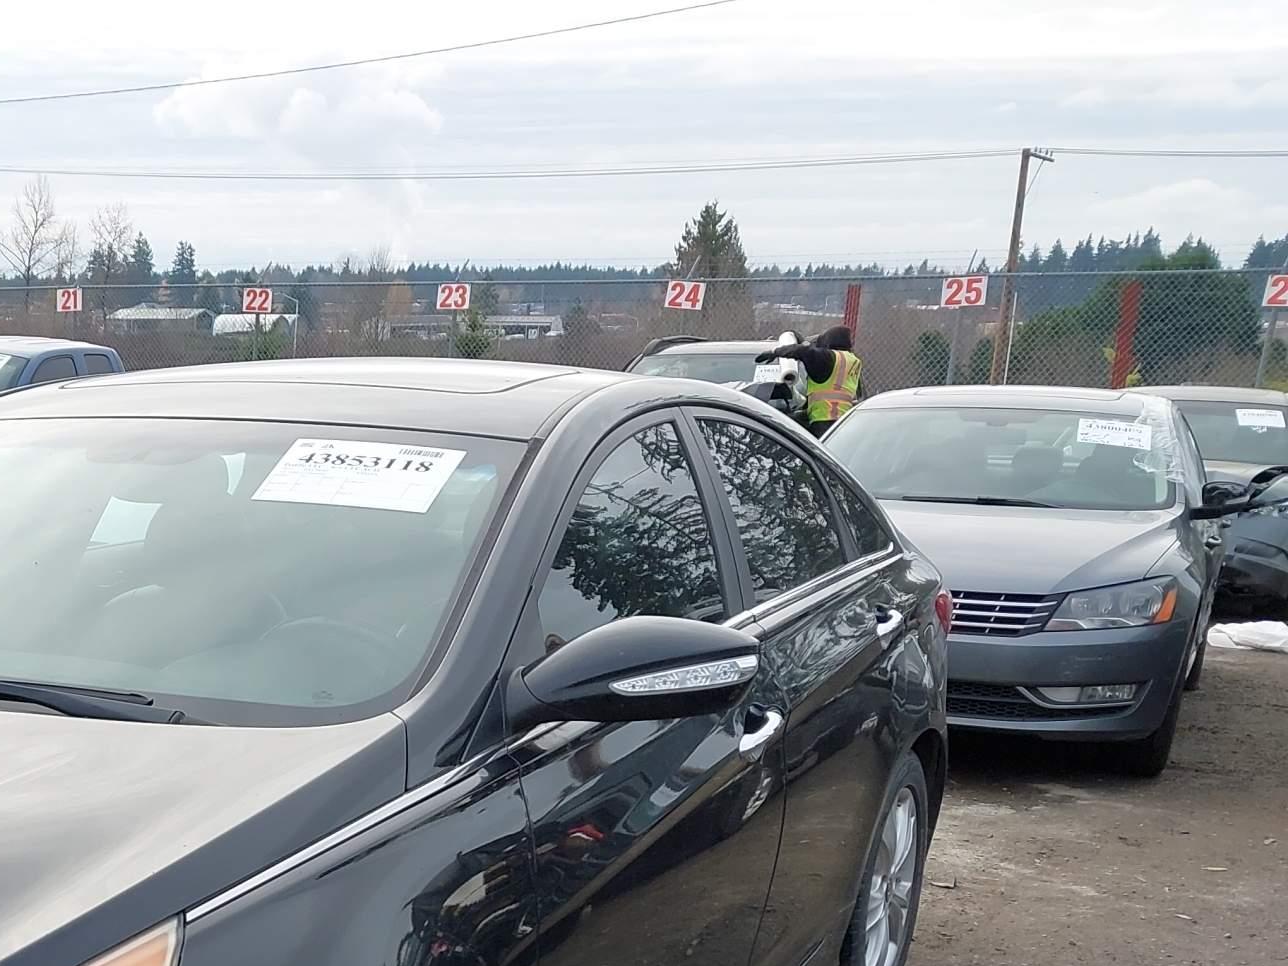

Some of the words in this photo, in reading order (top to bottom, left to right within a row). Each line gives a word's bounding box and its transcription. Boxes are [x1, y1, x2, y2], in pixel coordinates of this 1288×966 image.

[61, 290, 79, 310] 21
[245, 289, 270, 311] 22
[439, 285, 468, 308] 23
[668, 281, 702, 308] 24
[944, 277, 983, 305] 25
[298, 452, 434, 473] 43853118
